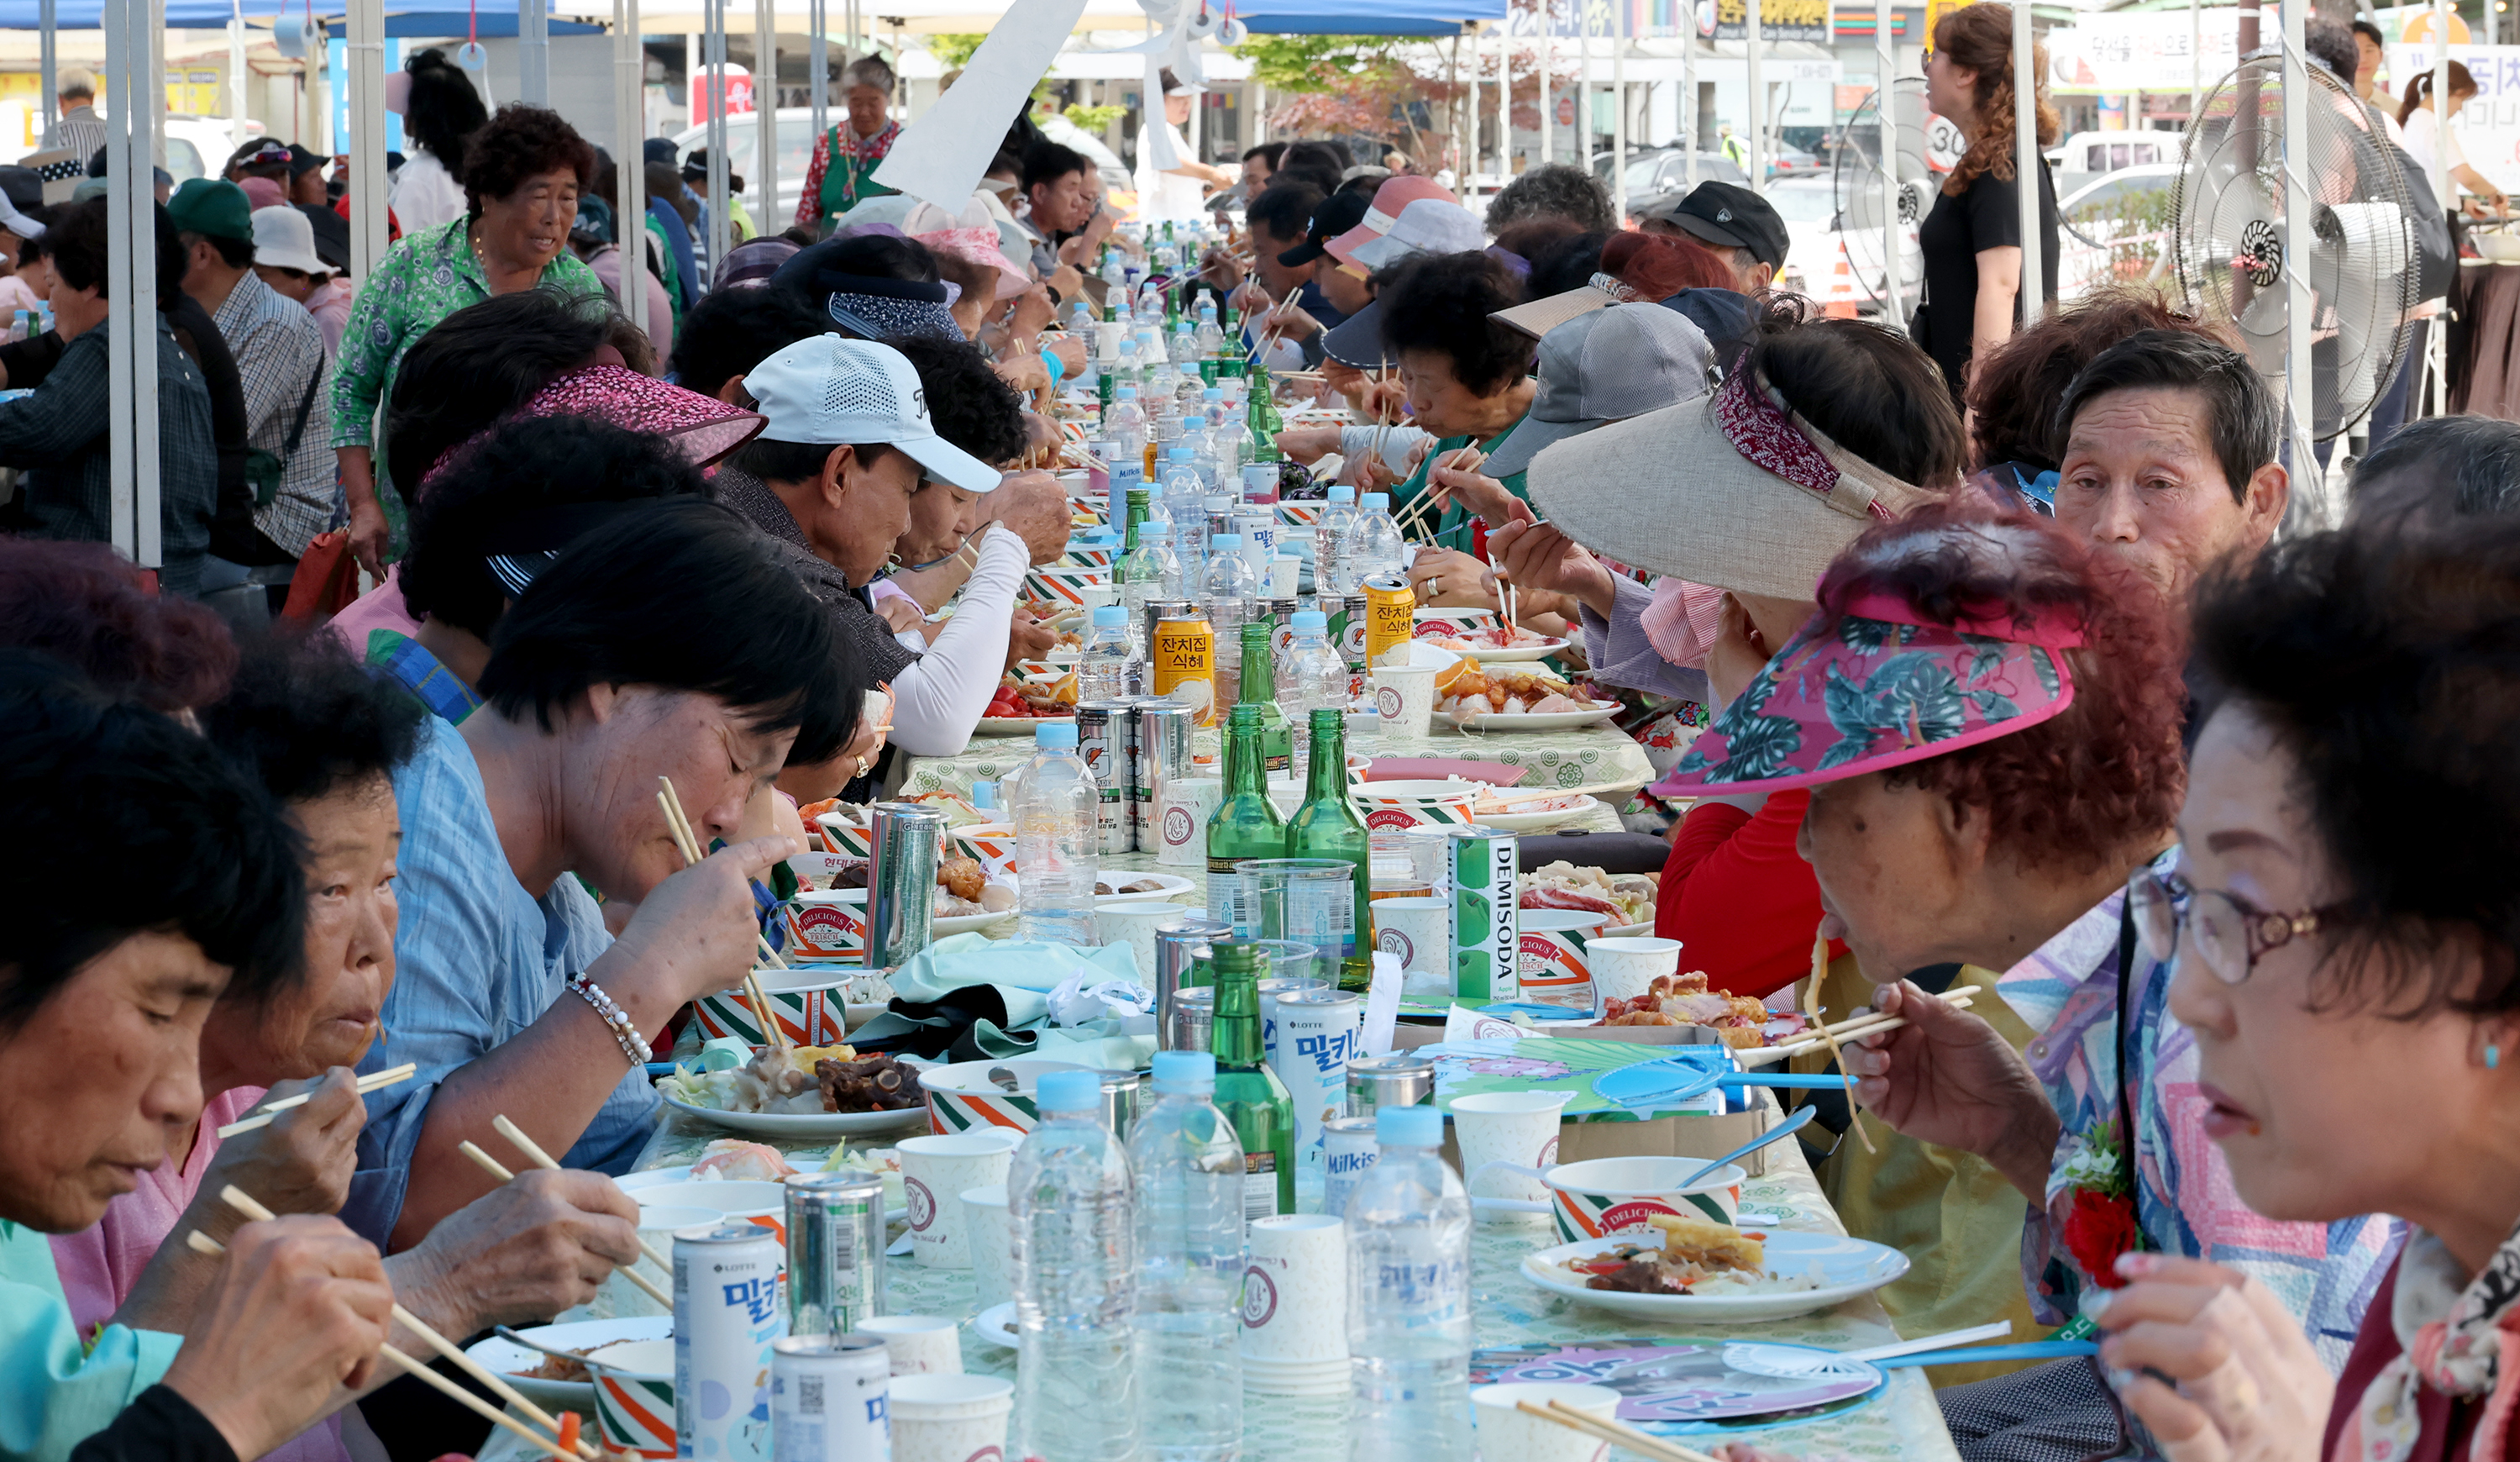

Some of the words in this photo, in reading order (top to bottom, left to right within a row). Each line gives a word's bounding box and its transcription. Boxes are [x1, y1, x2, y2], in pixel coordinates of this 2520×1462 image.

[2092, 36, 2131, 61] 당선을
[1934, 126, 1964, 155] 30
[1118, 468, 1140, 478] Milkis
[1377, 606, 1413, 620] 잔치집
[1420, 623, 1451, 633] DELICIOUS
[1162, 637, 1206, 653] 잔치집
[1173, 655, 1203, 669] 식혜
[1370, 814, 1410, 826] DELICIOUS
[803, 912, 845, 926] DELICIOUS
[1497, 847, 1513, 980] DEMISODA
[1328, 1152, 1377, 1175] Milkis
